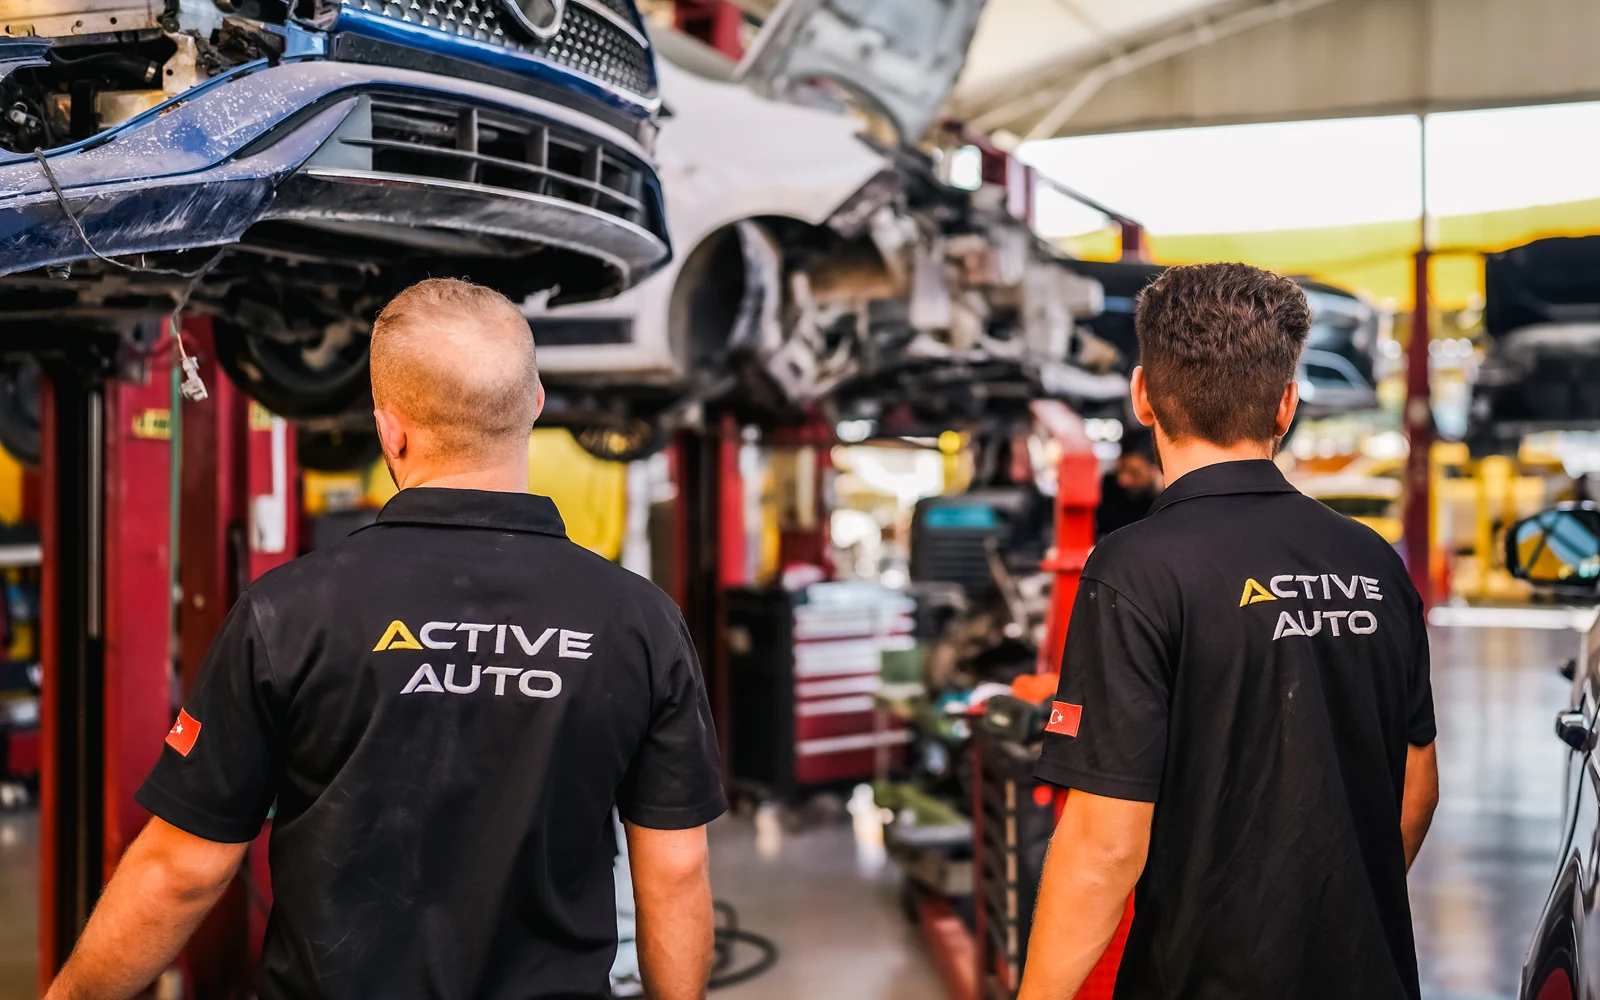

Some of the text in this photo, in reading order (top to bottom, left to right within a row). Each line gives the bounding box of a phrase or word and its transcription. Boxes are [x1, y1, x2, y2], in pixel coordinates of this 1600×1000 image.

[1239, 573, 1384, 608] ACTIVE
[372, 619, 594, 660] ACTIVE
[1272, 610, 1378, 641] AUTO
[399, 662, 563, 699] AUTO
